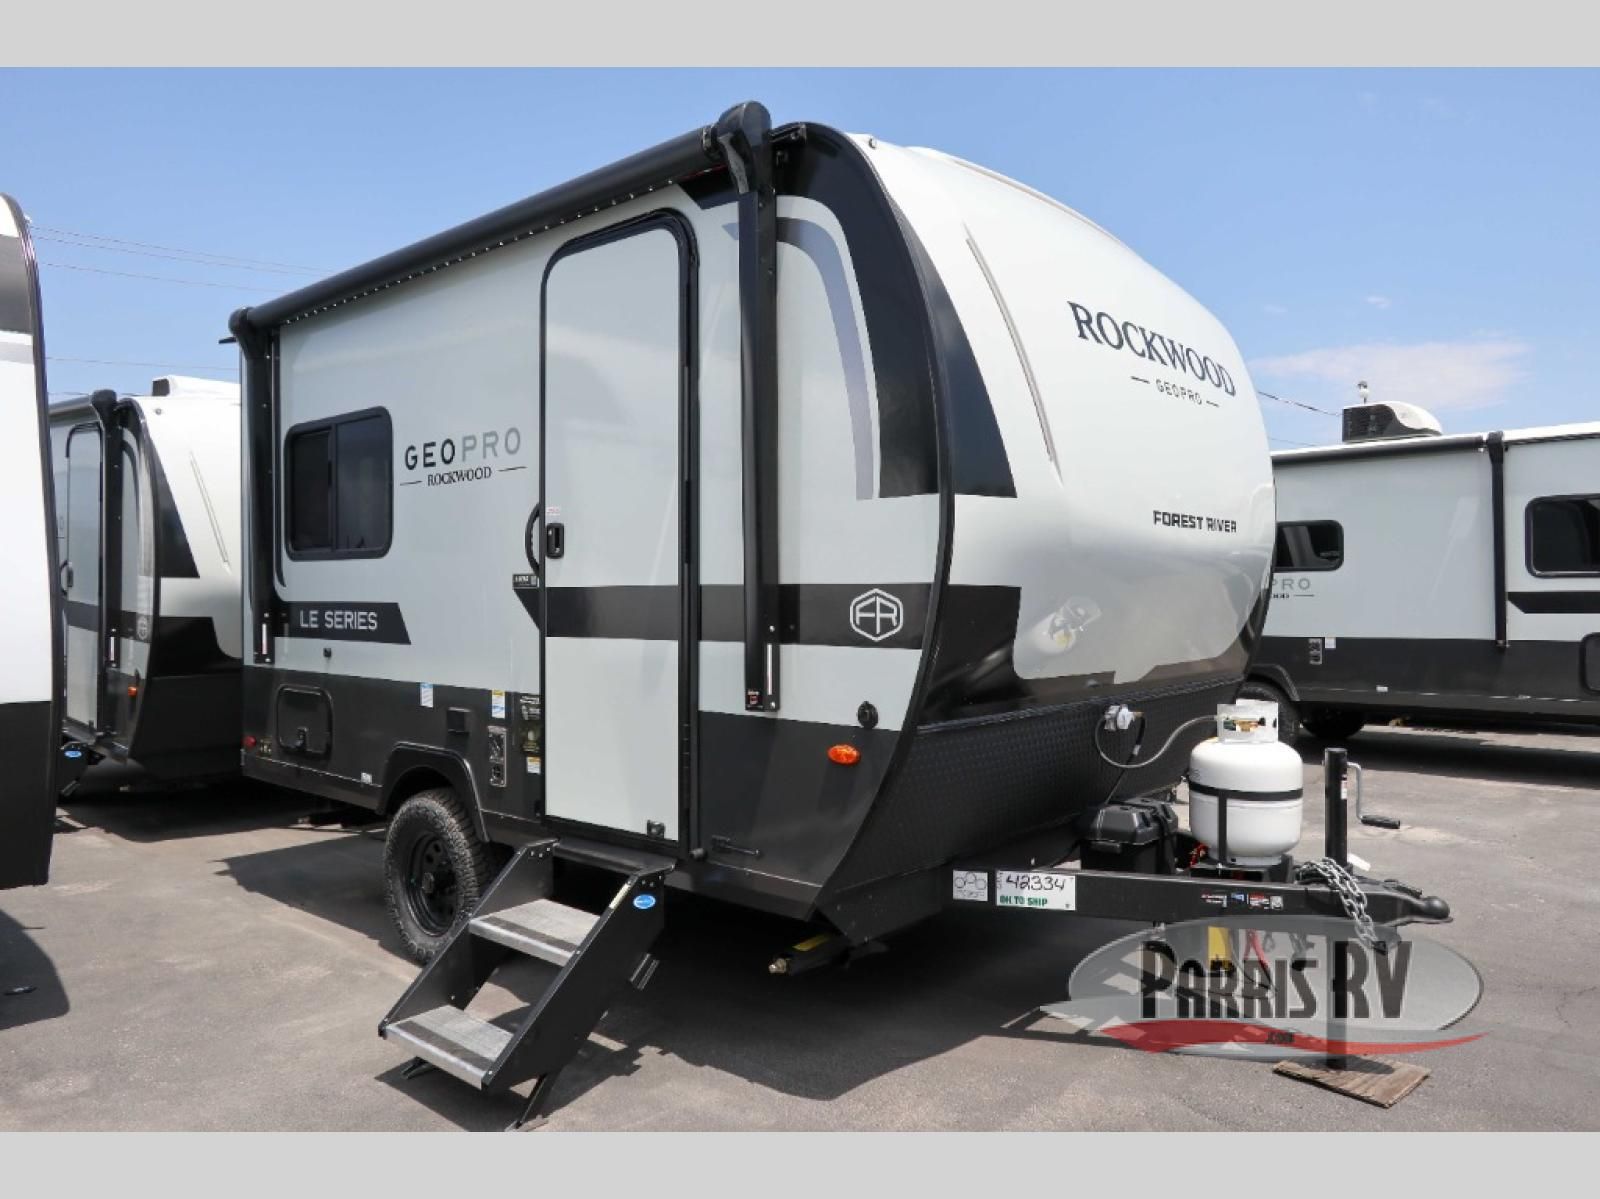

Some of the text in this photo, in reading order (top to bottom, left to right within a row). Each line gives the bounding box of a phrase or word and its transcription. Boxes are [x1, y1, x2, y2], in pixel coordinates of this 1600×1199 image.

[1066, 300, 1236, 397] ROCKWOOD
[1155, 378, 1203, 405] GEOPRO
[404, 427, 521, 471] GEOPRO
[427, 466, 492, 486] ROCKWOOD
[1153, 510, 1238, 533] FOREST RIVER
[300, 610, 378, 630] LE SERIES
[1005, 873, 1066, 892] 42334
[1028, 897, 1048, 907] SHIP
